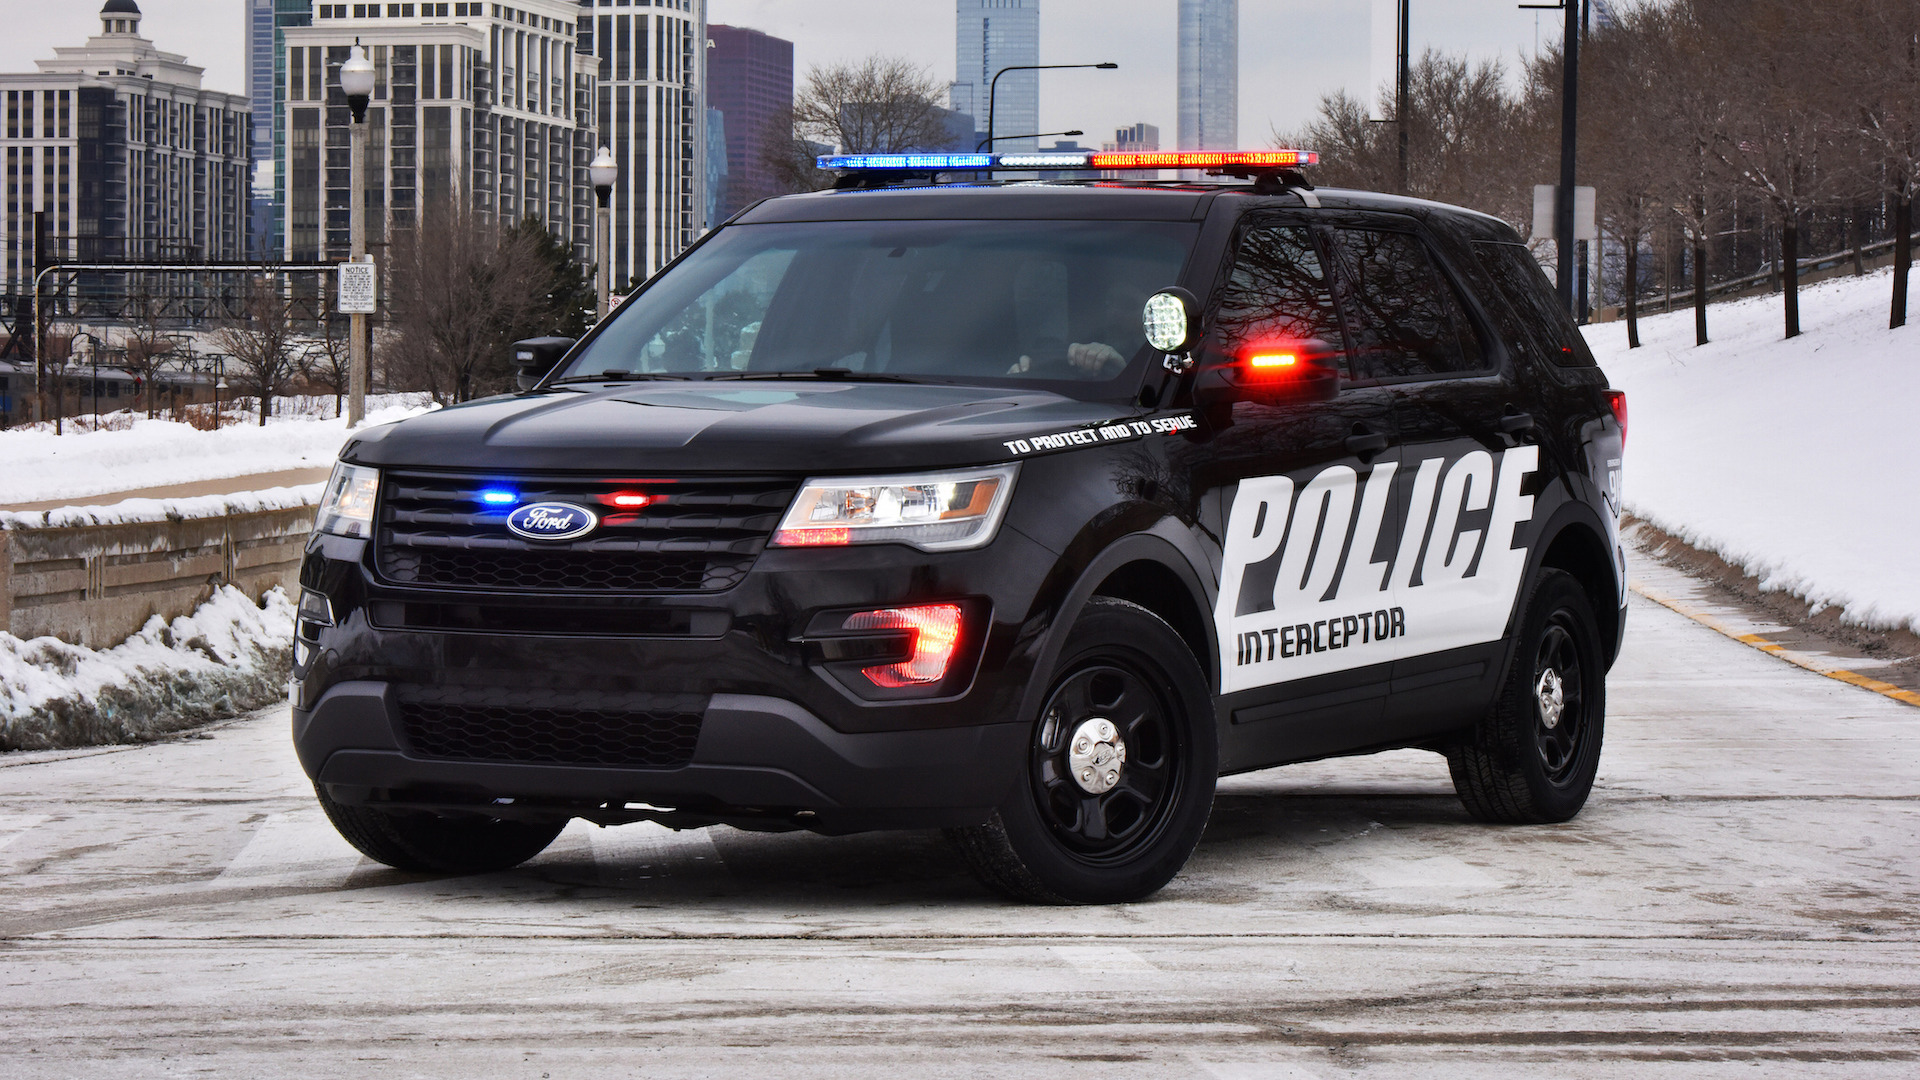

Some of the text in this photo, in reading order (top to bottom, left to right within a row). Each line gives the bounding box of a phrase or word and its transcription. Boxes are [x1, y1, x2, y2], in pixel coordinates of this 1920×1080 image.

[1003, 415, 1197, 455] TO PROTECT AND TO SERVE
[523, 507, 574, 530] Ford
[1216, 444, 1539, 618] POLICE
[1237, 606, 1405, 666] INTERCEPTOR
